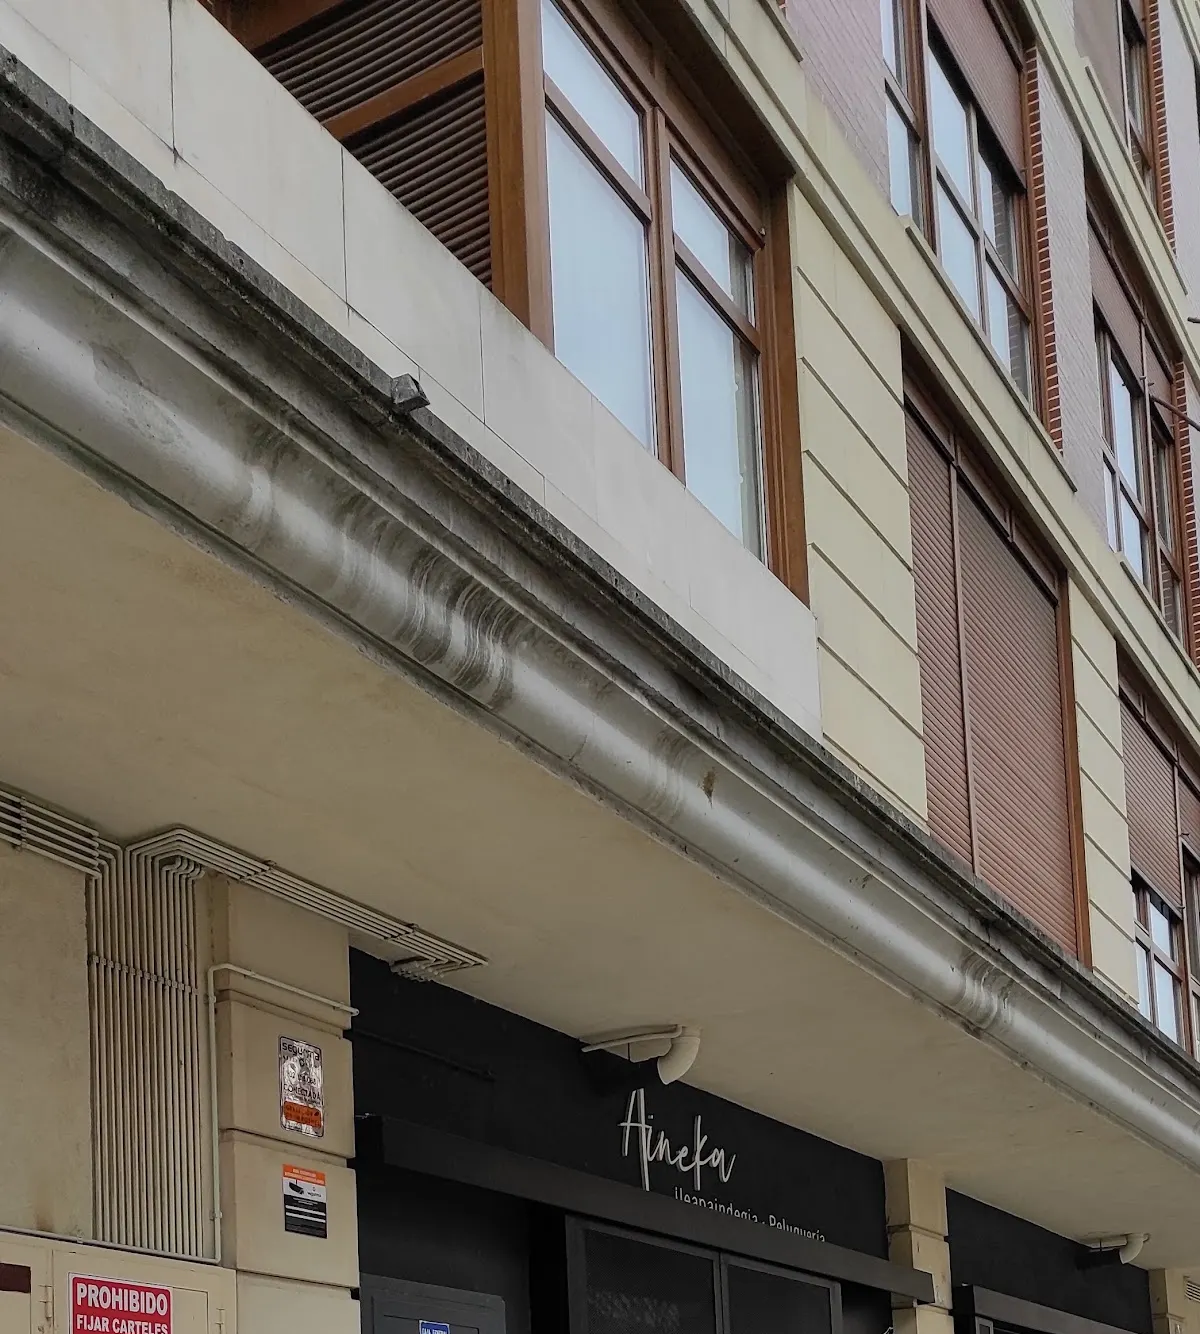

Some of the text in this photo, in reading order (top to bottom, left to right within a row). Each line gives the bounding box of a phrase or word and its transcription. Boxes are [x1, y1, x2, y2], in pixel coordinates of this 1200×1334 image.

[617, 1088, 736, 1192] Aineka
[76, 1282, 168, 1316] PROHIBIDO
[76, 1314, 110, 1333] FIJAR
